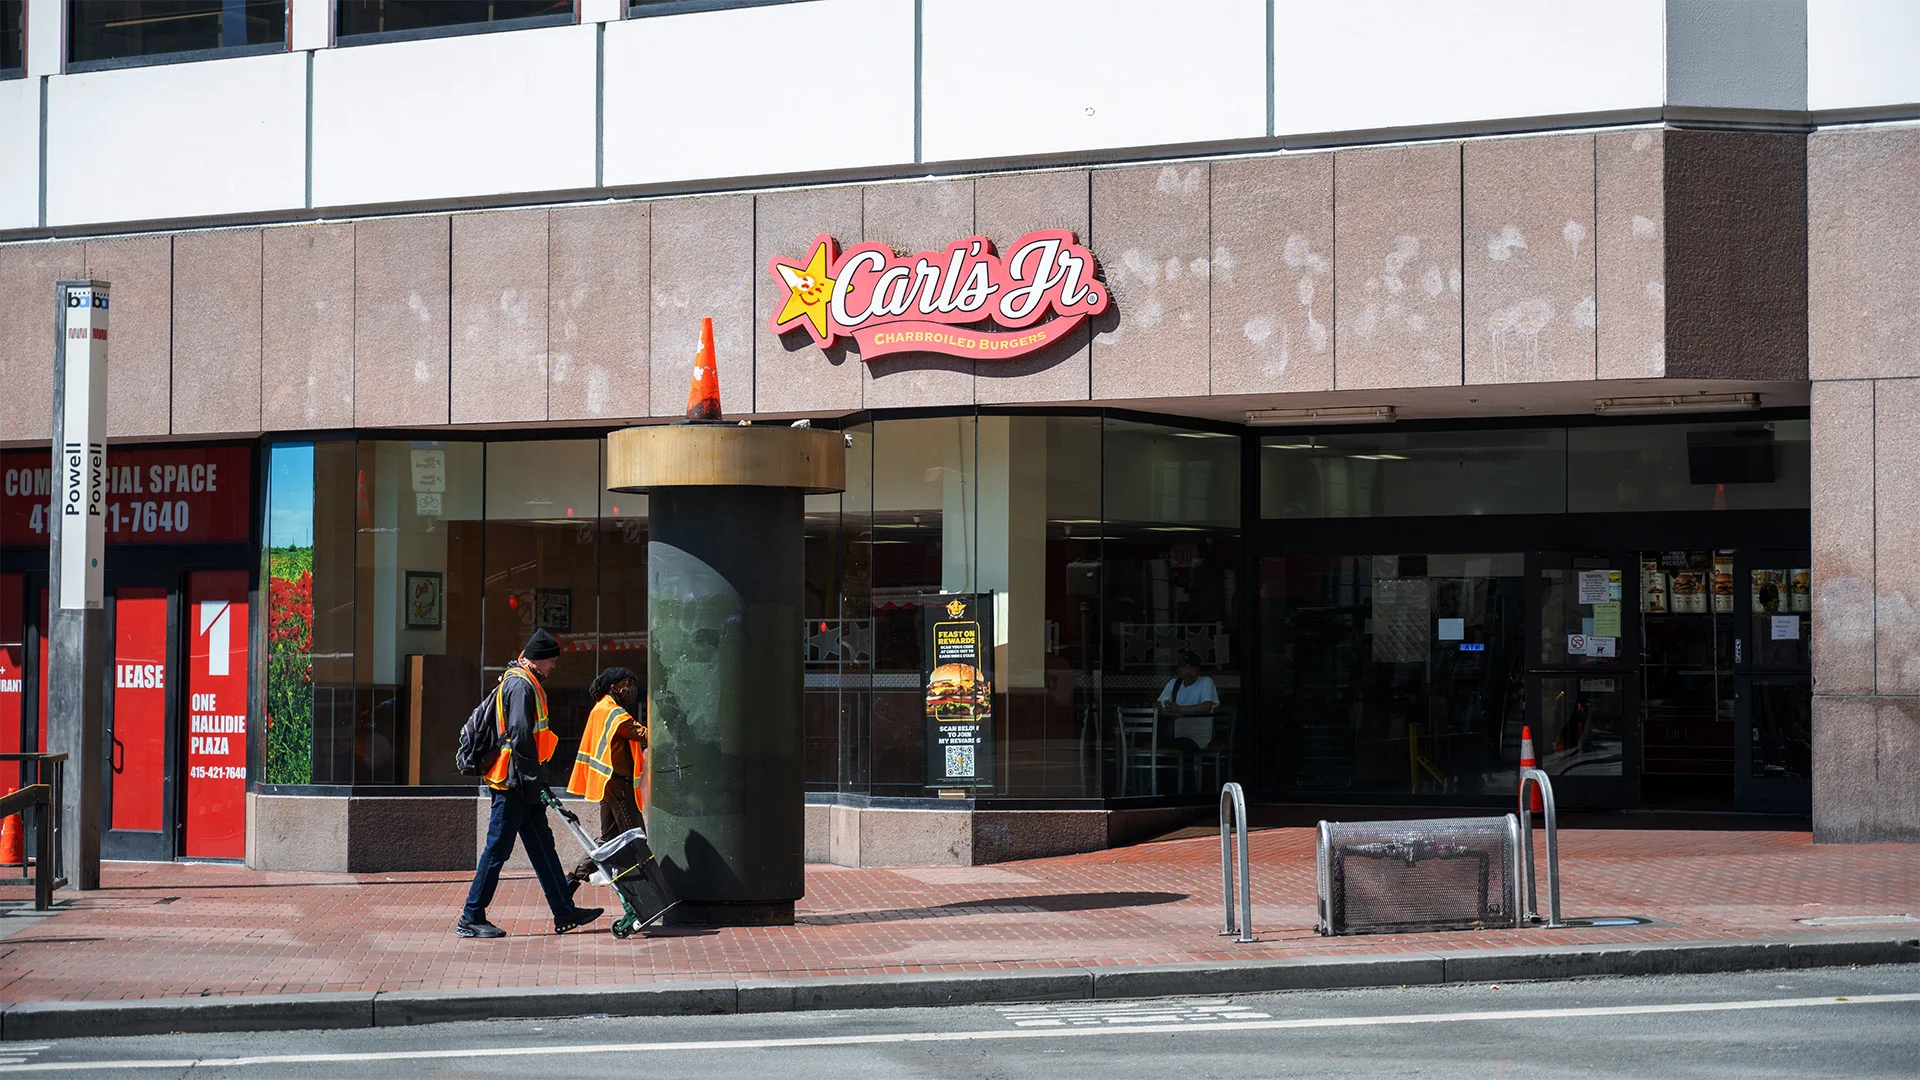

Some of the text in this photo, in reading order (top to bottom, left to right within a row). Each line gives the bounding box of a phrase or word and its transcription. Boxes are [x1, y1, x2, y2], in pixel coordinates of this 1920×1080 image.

[830, 238, 1100, 326] Carl's Jr.
[874, 331, 1046, 350] CHARBROILED BURGERS
[65, 443, 81, 516] Powell
[89, 443, 102, 516] Powell
[149, 464, 217, 494] SPACE
[117, 664, 164, 689] LEASE
[191, 693, 216, 712] ONE
[191, 715, 246, 733] HALLIDIE
[191, 736, 229, 755] PLAZA
[190, 766, 247, 779] 415-421-7640
